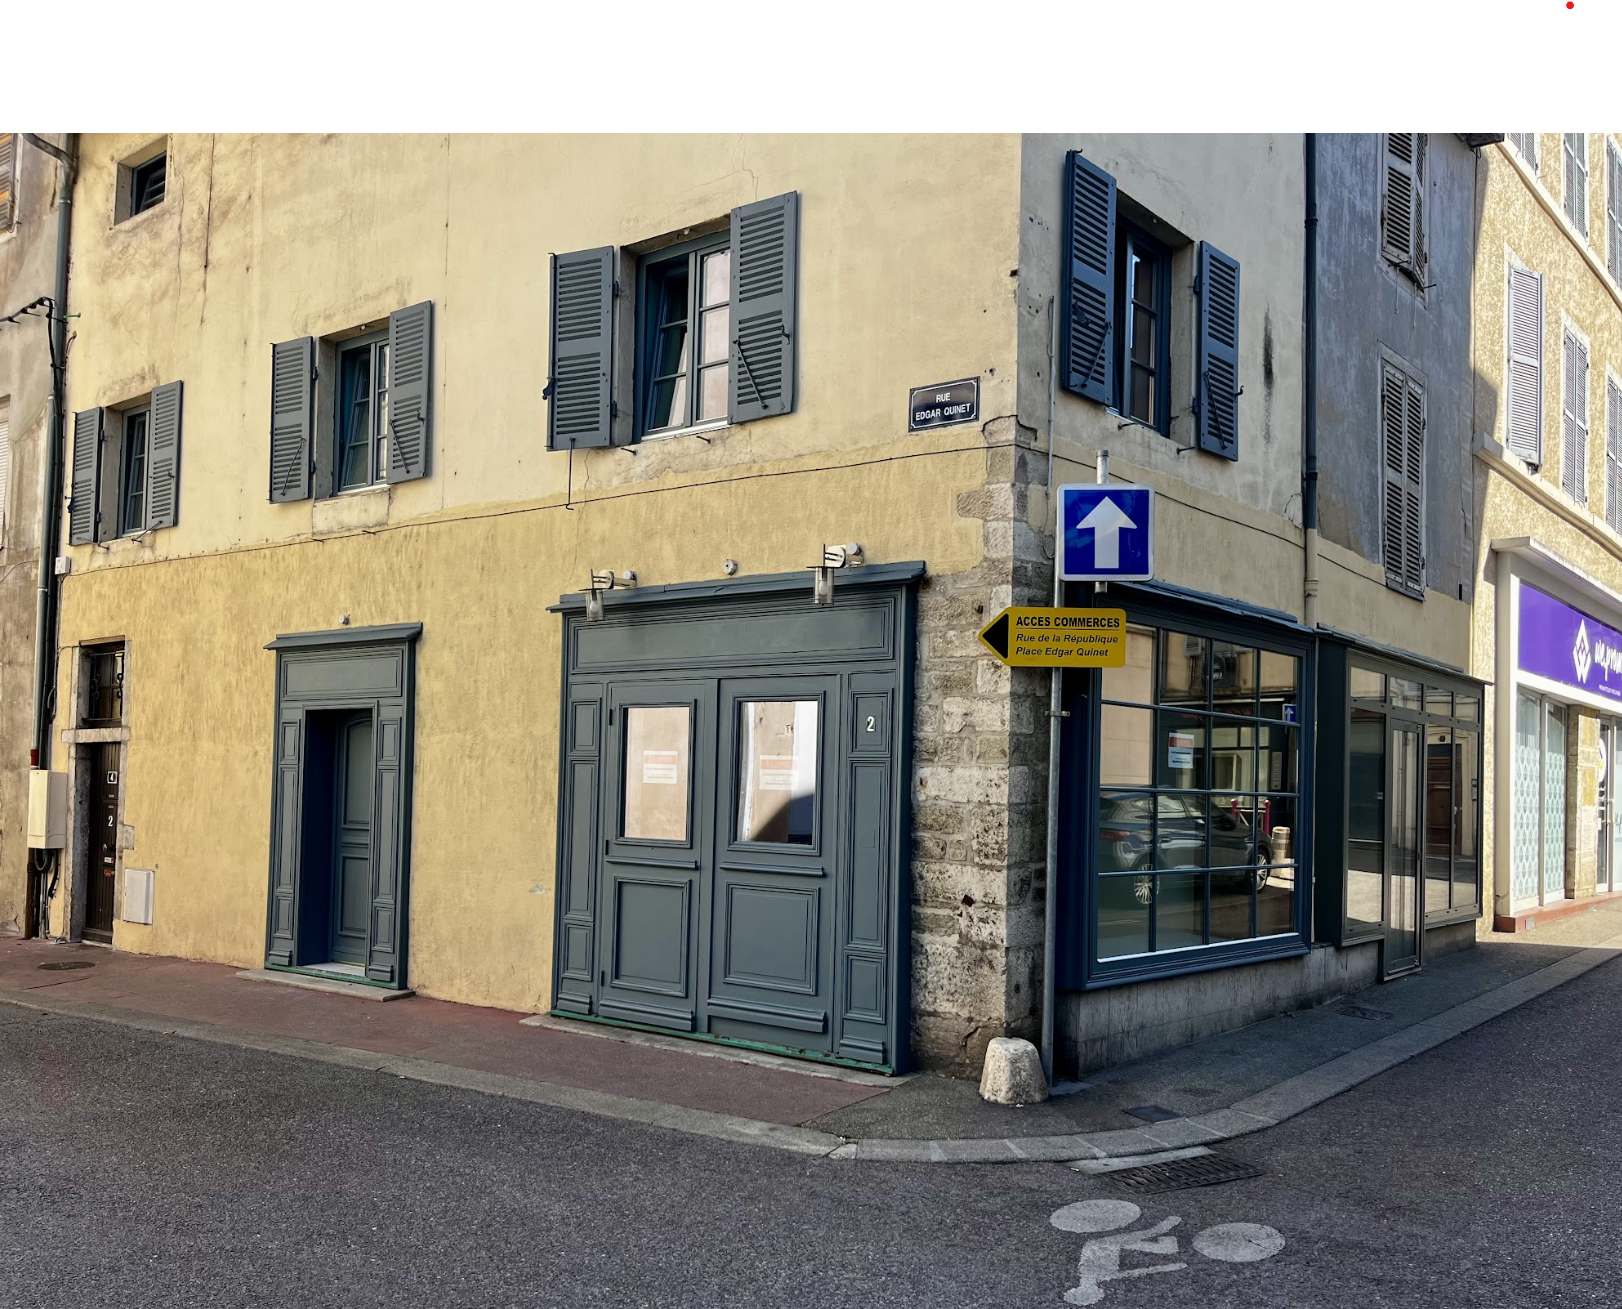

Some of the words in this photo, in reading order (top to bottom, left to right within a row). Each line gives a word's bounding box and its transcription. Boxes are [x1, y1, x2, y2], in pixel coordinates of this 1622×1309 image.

[936, 392, 951, 403] RUE
[915, 408, 941, 421] EDGAR
[943, 403, 971, 416] QUINET
[1015, 616, 1051, 627] ACCES
[1053, 617, 1120, 628] COMMERCES
[1015, 633, 1036, 642] Rue
[1037, 634, 1050, 642] de
[1052, 634, 1061, 643] la
[1063, 634, 1119, 645] République
[1015, 646, 1043, 656] Place
[1045, 647, 1074, 658] Edgar
[1076, 647, 1109, 657] Quinet
[866, 715, 875, 732] 2
[107, 815, 114, 827] 2
